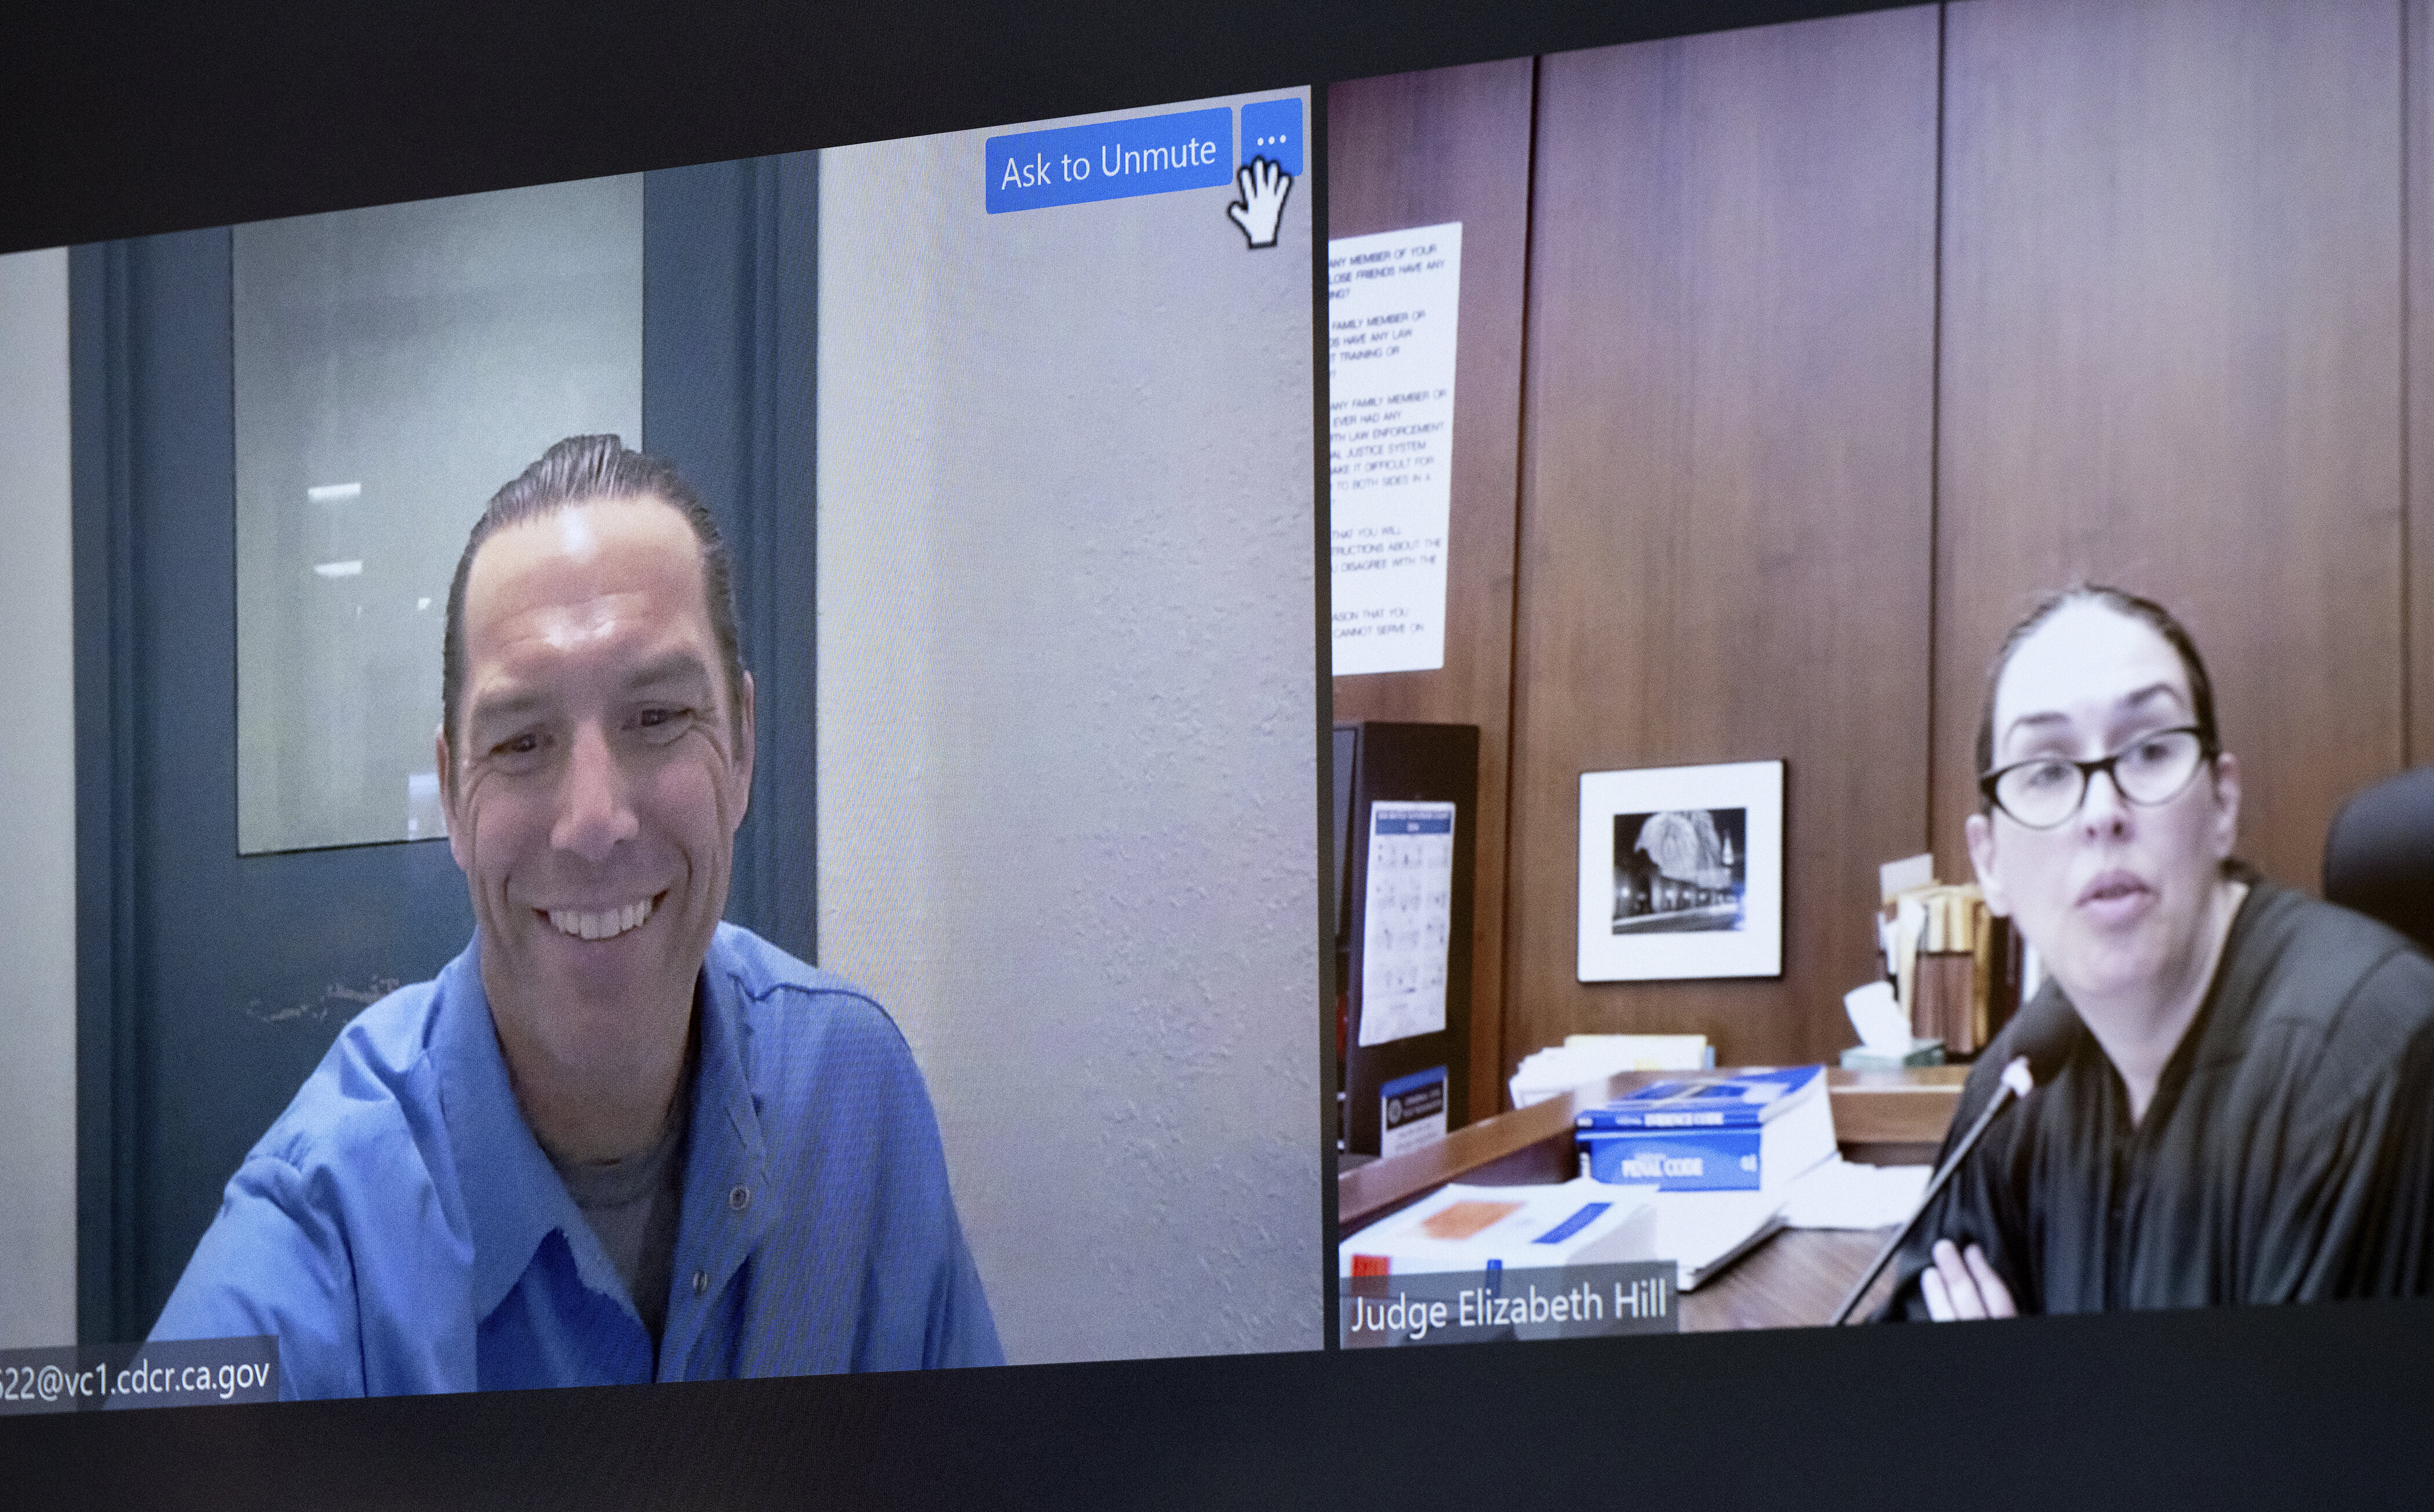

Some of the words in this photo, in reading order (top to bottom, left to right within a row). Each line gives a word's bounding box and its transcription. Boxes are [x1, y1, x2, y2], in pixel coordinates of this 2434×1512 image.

[1001, 153, 1051, 190] Ask
[1061, 154, 1091, 183] to
[1102, 137, 1217, 177] Unmute
[1350, 250, 1390, 265] MEMBER
[1394, 248, 1406, 260] OF
[1412, 243, 1437, 256] YOUR
[1356, 266, 1394, 279] FRIENDS
[1398, 262, 1422, 273] HAVE
[1426, 260, 1445, 269] ANY
[1332, 319, 1362, 330] FAMILY
[1367, 312, 1408, 326] MEMBER
[1412, 310, 1426, 321] OR
[1343, 334, 1366, 345] HAVE
[1371, 331, 1388, 342] ANY
[1392, 329, 1412, 340] LAW
[1340, 348, 1382, 360] TRAINING
[1386, 346, 1400, 356] OR
[1353, 397, 1383, 407] FAMILY
[1388, 391, 1429, 404] MEMBER
[1433, 389, 1446, 399] OR
[1333, 416, 1356, 427] EVER
[1361, 413, 1380, 423] HAD
[1384, 411, 1401, 421] ANY
[1349, 431, 1368, 441] LAW
[1373, 421, 1444, 439] ENFORCEMENT
[1347, 445, 1383, 458] JUSTICE
[1389, 441, 1426, 454] SYSTEM
[1354, 463, 1360, 472] IT
[1365, 458, 1411, 472] DIFFICULT
[1415, 456, 1434, 466] FOR
[1353, 478, 1378, 490] BOTH
[1358, 527, 1378, 538] YOU
[1389, 539, 1419, 551] ABOUT
[1424, 537, 1441, 548] THE
[1342, 559, 1387, 572] DISAGREE
[1392, 556, 1415, 566] WITH
[1420, 555, 1436, 565] THE
[1377, 622, 1405, 636] SERVE
[1351, 1292, 1447, 1340] Judge
[1459, 1282, 1604, 1327] Elizabeth
[1615, 1277, 1667, 1319] Hill
